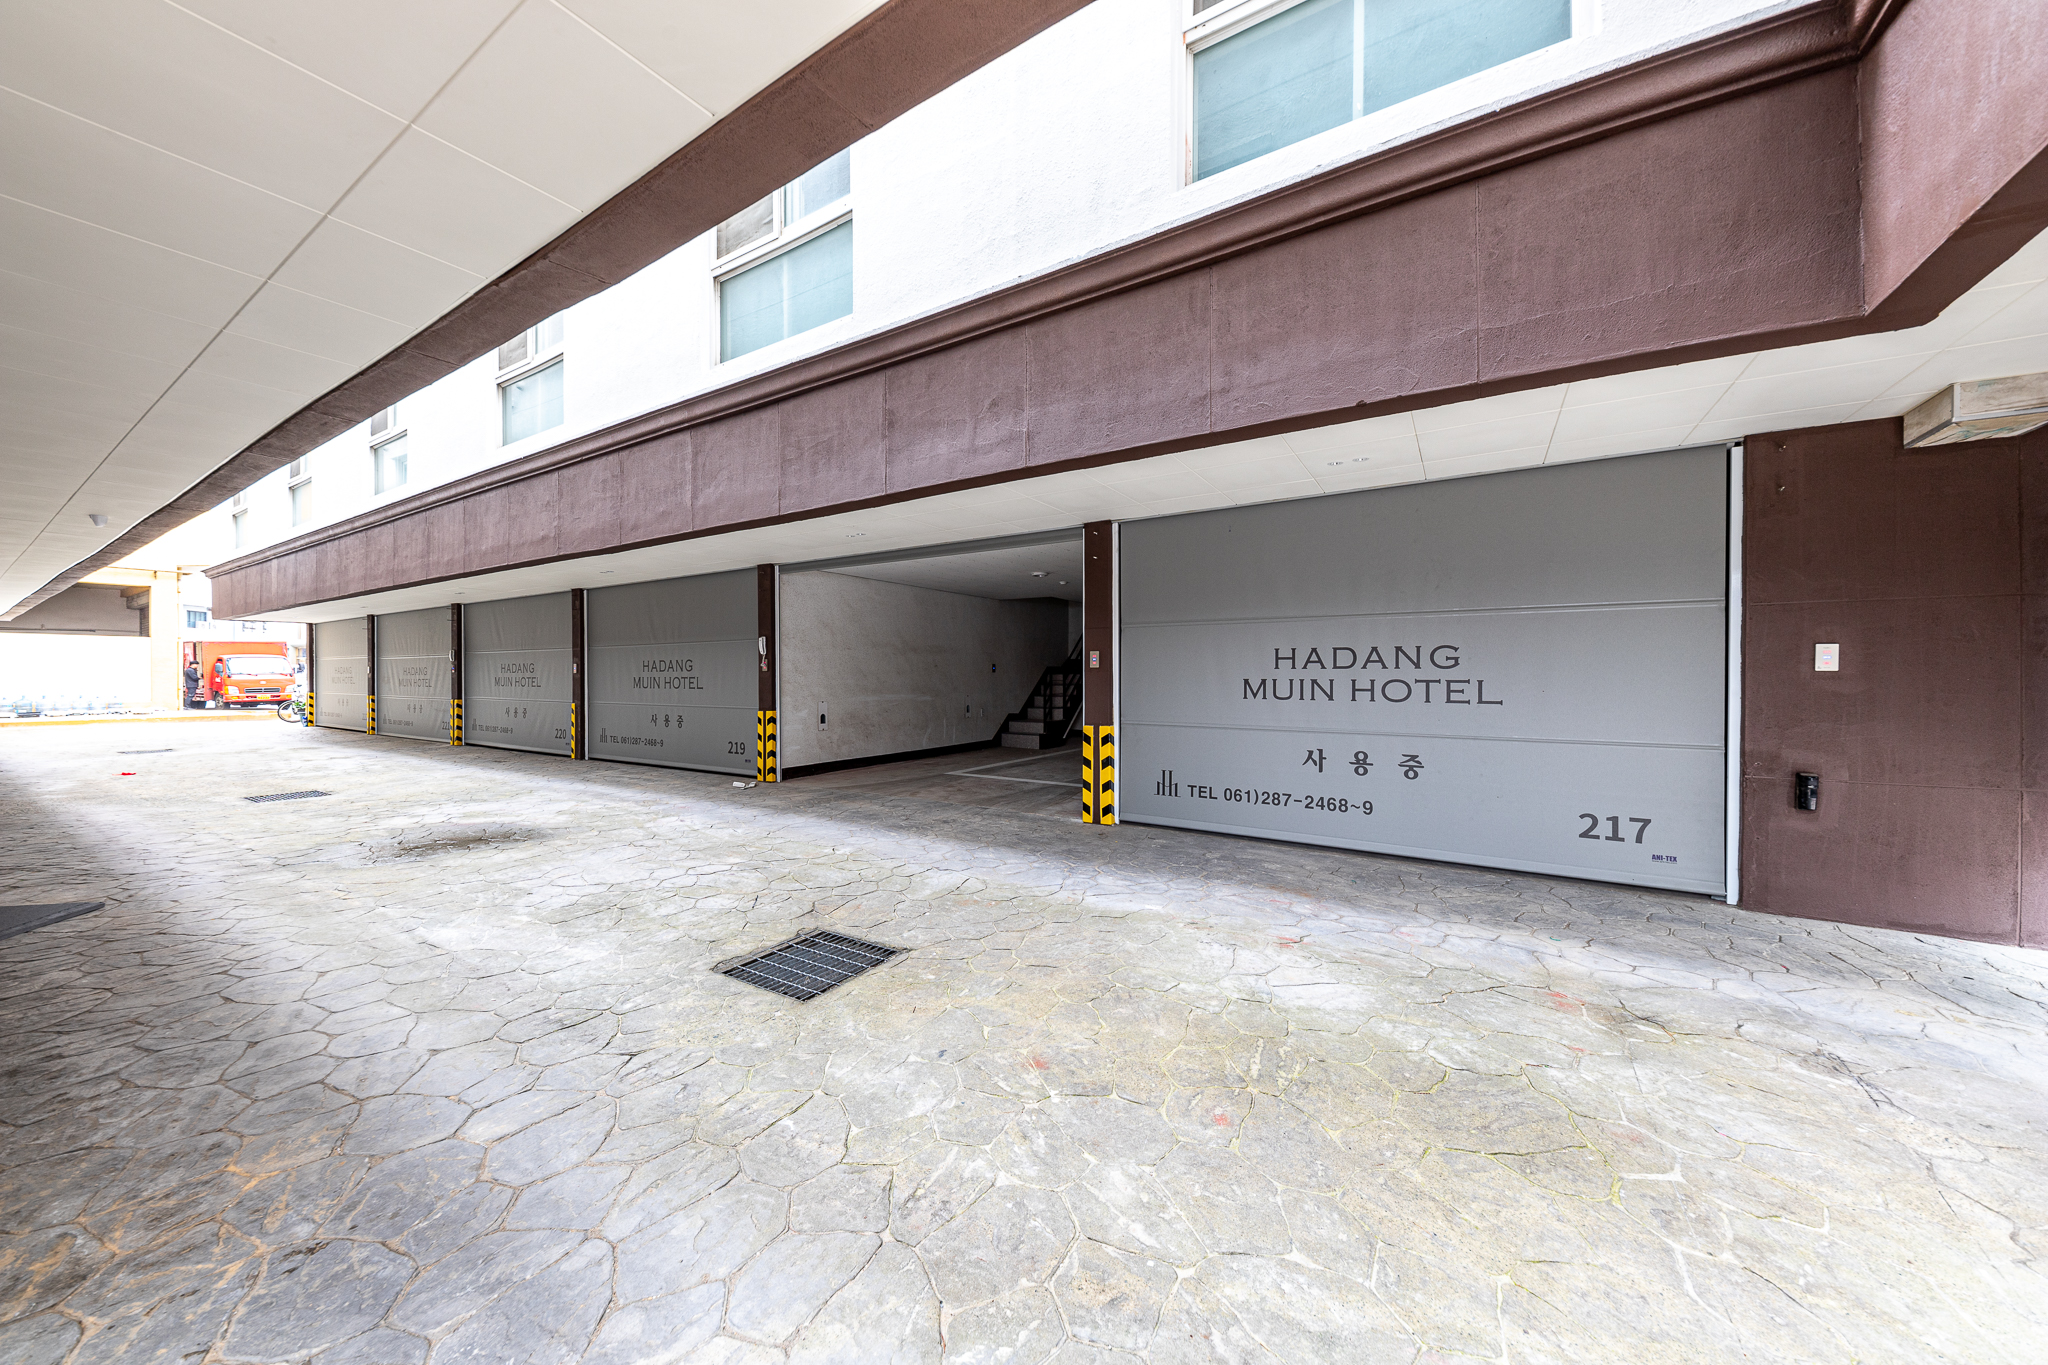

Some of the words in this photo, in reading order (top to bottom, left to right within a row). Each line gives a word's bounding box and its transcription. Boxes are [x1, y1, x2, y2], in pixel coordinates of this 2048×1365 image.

[1273, 644, 1461, 670] HADANG
[500, 663, 535, 674] HADANG
[642, 659, 694, 673] HADANG
[494, 677, 513, 687] MUIN
[515, 676, 541, 688] HOTEL
[633, 676, 661, 689] MUIN
[664, 676, 704, 690] HOTEL
[1242, 678, 1335, 701] MUIN
[1350, 678, 1504, 706] HOTEL
[554, 728, 567, 740] 220
[609, 735, 620, 744] TEL
[727, 741, 746, 755] 219
[1187, 784, 1218, 800] TEL
[1223, 787, 1374, 816] 061)287-2468~9
[1578, 812, 1652, 844] 217
